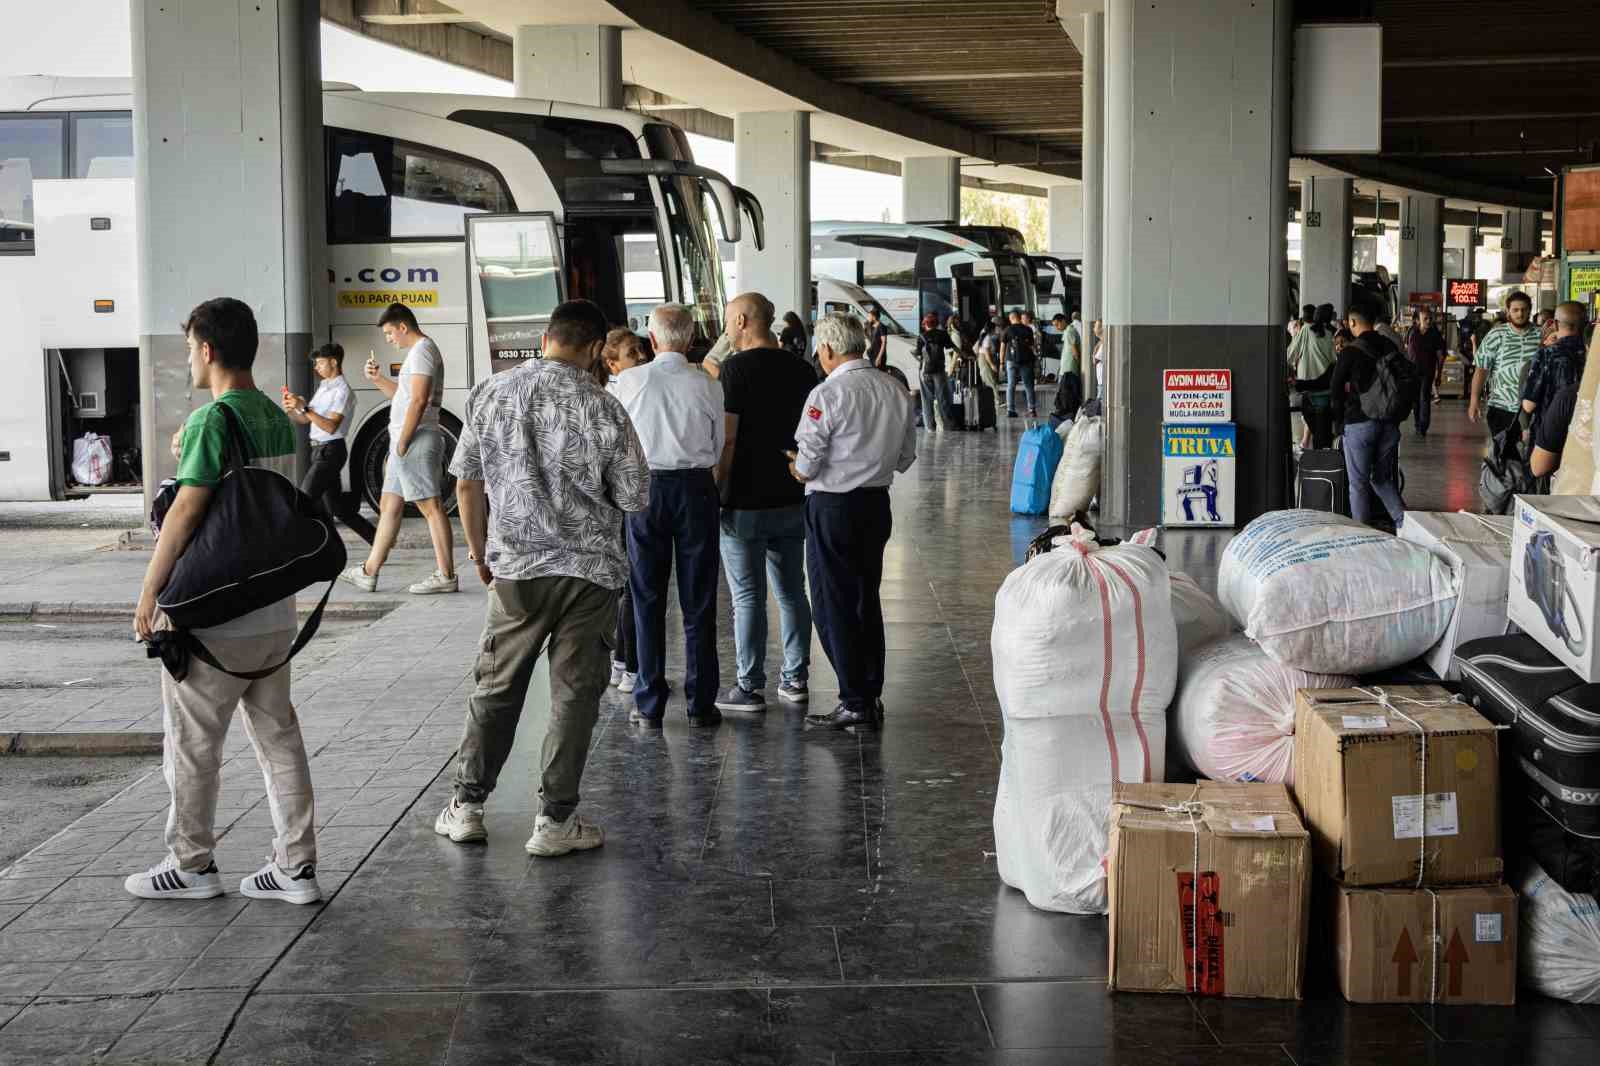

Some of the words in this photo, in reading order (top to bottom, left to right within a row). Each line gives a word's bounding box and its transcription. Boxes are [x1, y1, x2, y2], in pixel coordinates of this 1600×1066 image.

[342, 294, 365, 304] %10
[368, 294, 398, 303] PARA
[401, 294, 432, 303] PUAN
[498, 350, 518, 359] 0530
[1167, 374, 1194, 386] AYDIN
[1195, 373, 1227, 386] MUĞLA
[1168, 438, 1233, 456] TRUVA
